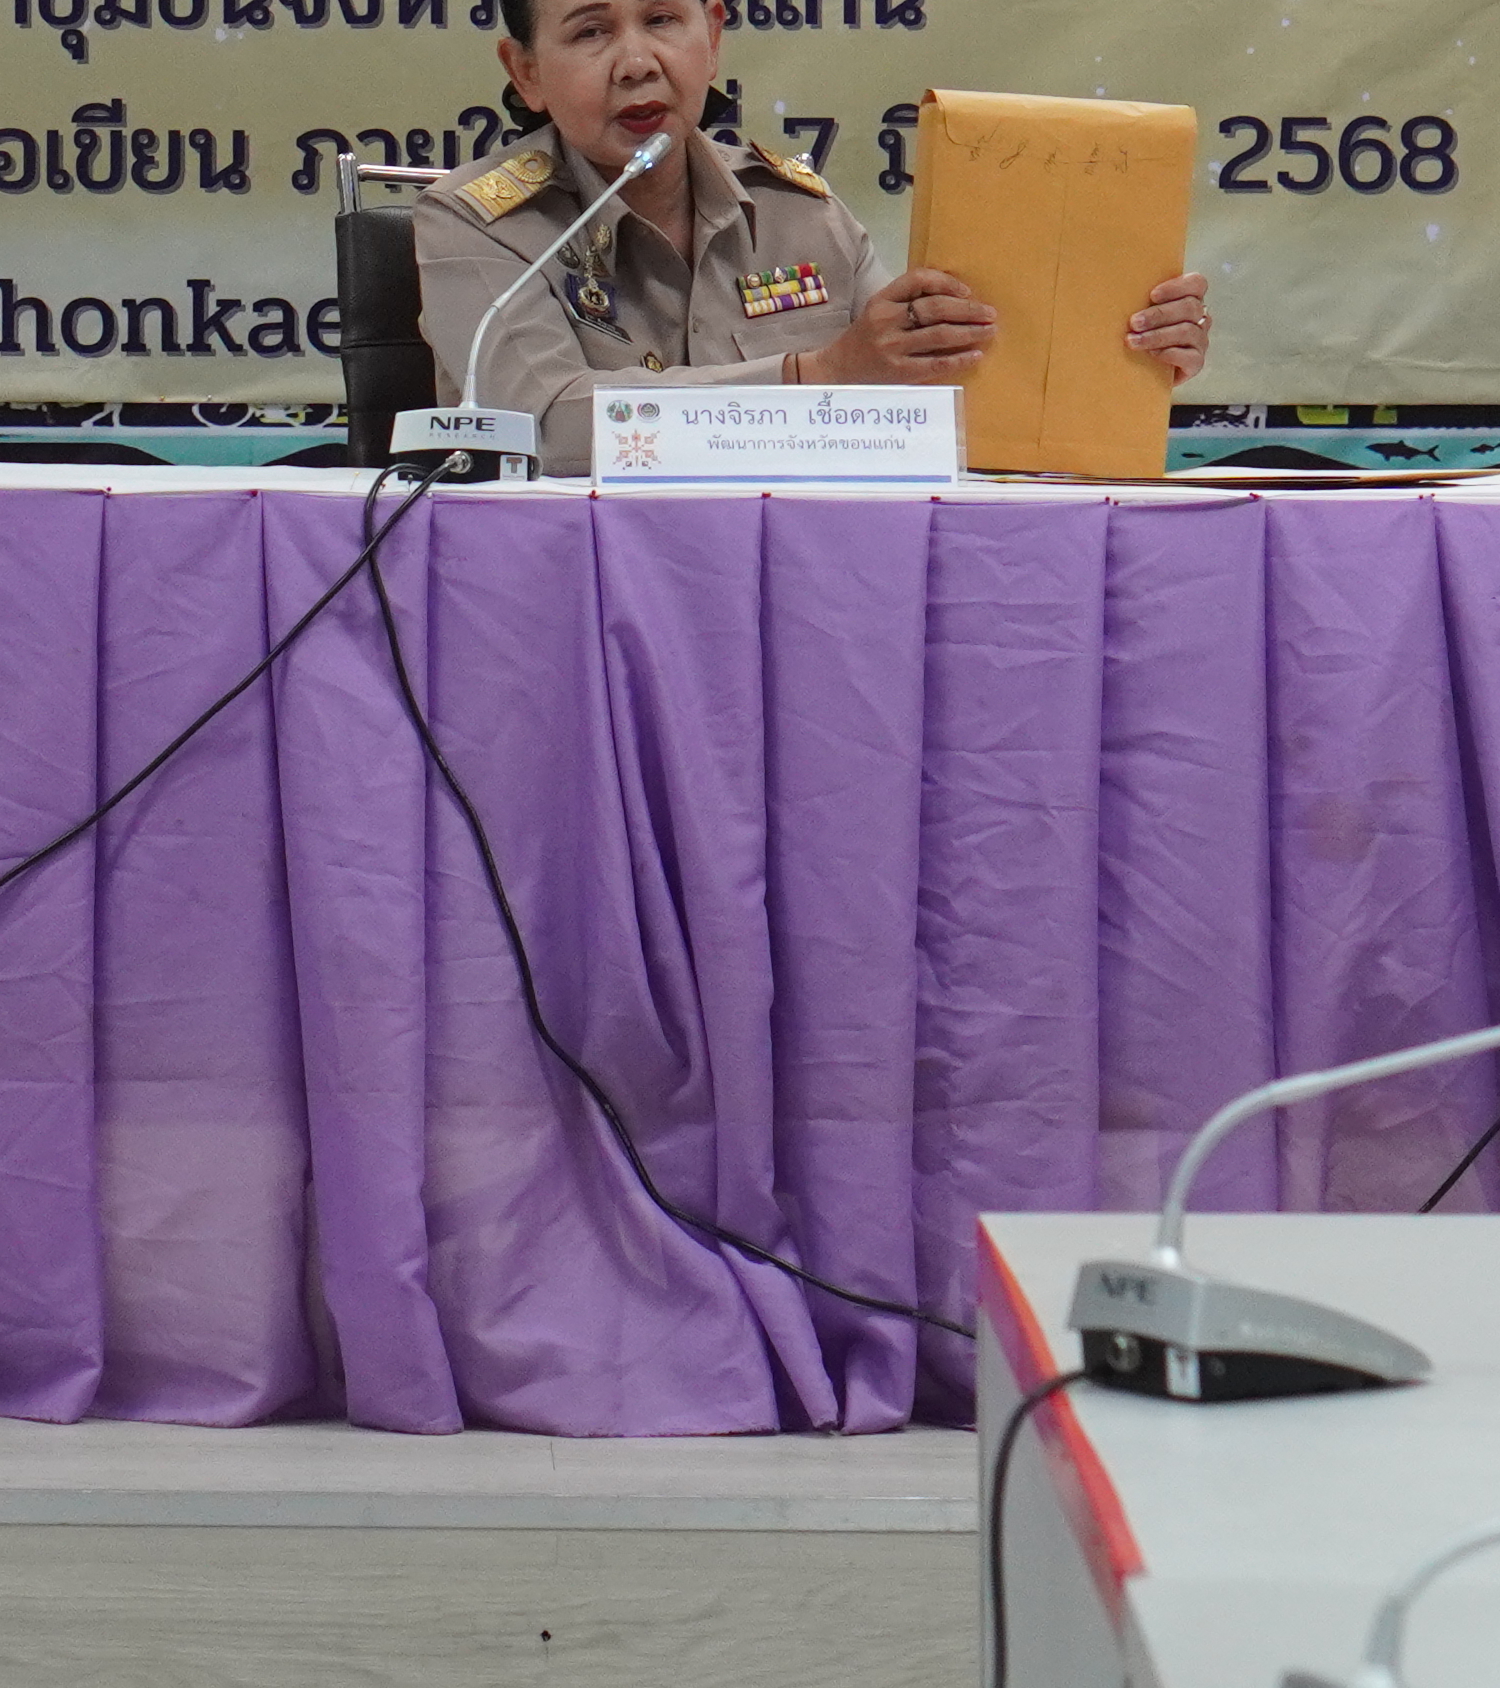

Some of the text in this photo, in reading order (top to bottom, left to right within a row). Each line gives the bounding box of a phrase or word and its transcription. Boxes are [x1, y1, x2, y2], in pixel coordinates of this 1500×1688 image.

[783, 116, 836, 178] 7
[1217, 114, 1457, 193] 2568
[430, 416, 497, 432] NPE
[681, 401, 789, 427] นางจิรภา
